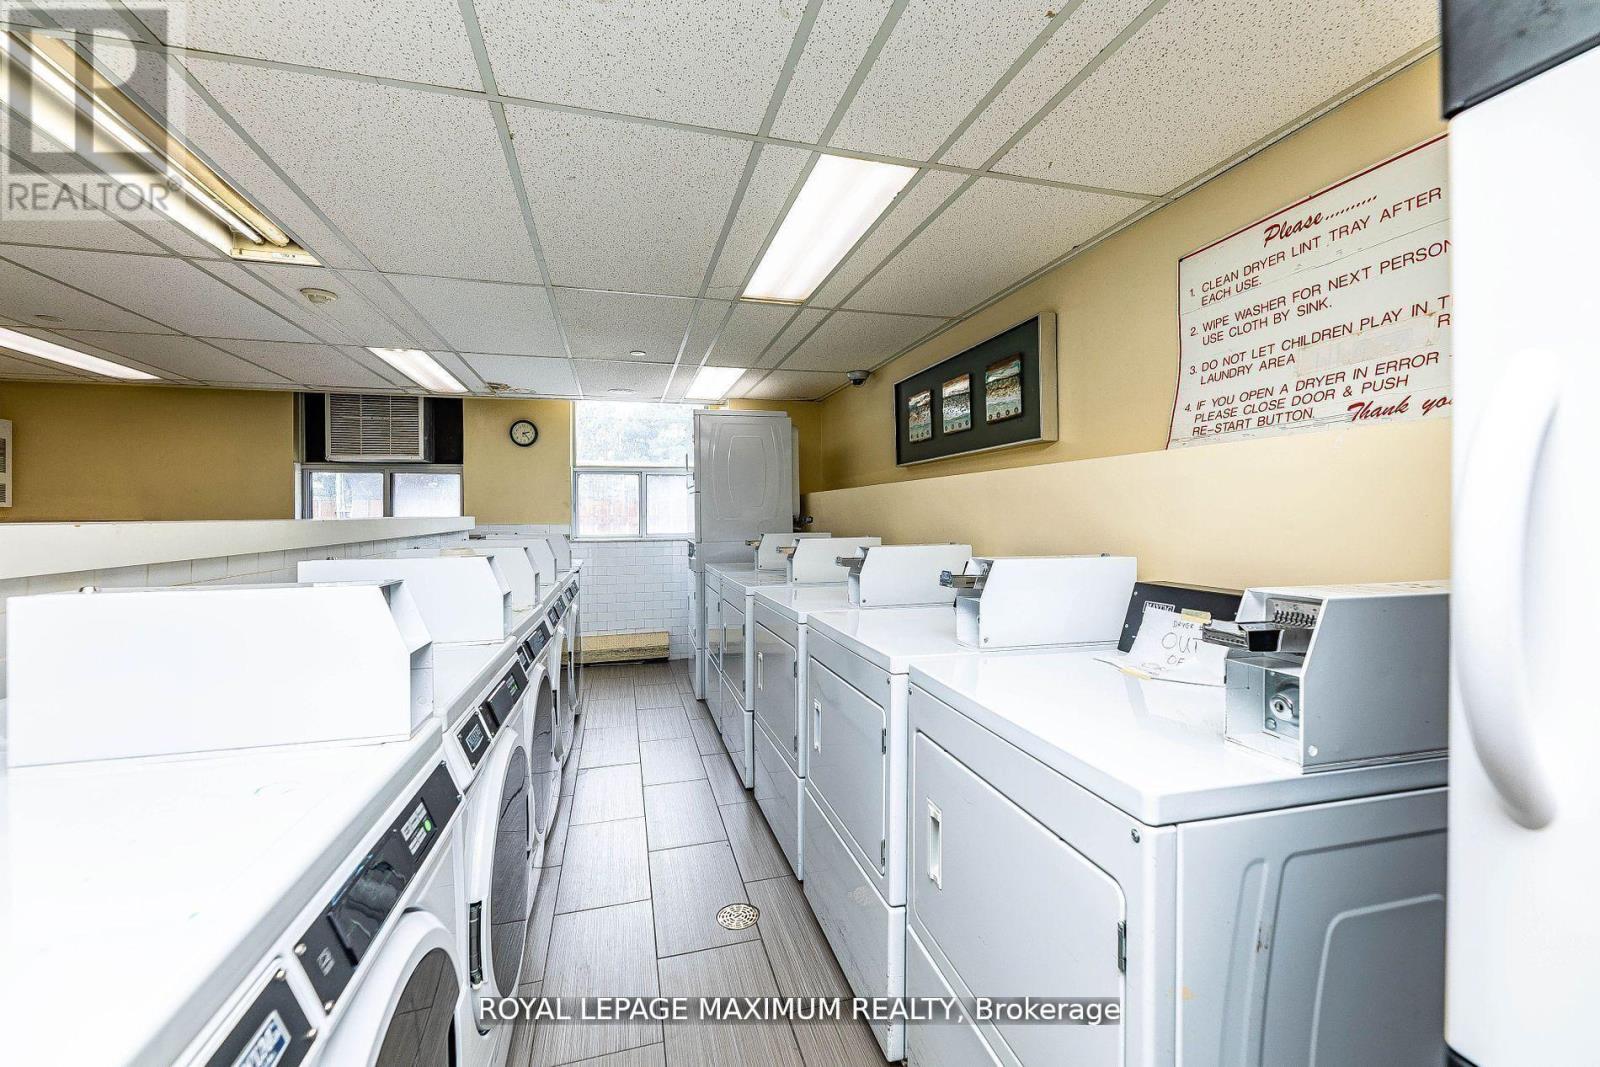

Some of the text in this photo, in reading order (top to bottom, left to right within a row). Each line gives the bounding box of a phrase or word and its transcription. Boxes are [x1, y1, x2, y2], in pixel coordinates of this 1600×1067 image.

[1201, 270, 1239, 293] CLEAN
[1243, 251, 1286, 277] DRYER
[1291, 236, 1321, 258] LINT
[1328, 215, 1371, 242] TRAY
[1379, 187, 1442, 223] AFTER
[1190, 326, 1199, 337] 2.
[1202, 314, 1230, 333] WIPE
[1234, 296, 1287, 322] WASHER
[1292, 283, 1322, 303] FOR
[1328, 265, 1372, 291] NEXT
[1201, 275, 1262, 306] EACH USE.
[1189, 365, 1198, 376] 3.
[1201, 359, 1218, 373] DO
[1222, 351, 1247, 366] NOT
[1251, 343, 1276, 359] LET
[1281, 322, 1353, 352] CHILDREN
[1359, 308, 1403, 331] PLAY
[1411, 301, 1428, 318] IN
[1202, 297, 1332, 346] USE CLOTH BY SINK.
[1184, 351, 1440, 413] 4. IF YOU OPEN A DRYER IN ERROR
[1200, 353, 1296, 386] LAUNDRY AREA
[1191, 407, 1315, 437] RE-START BUTTON.
[1194, 374, 1409, 423] PLEASE CLOSE DOOR & PUSH
[1347, 395, 1412, 422] Thank
